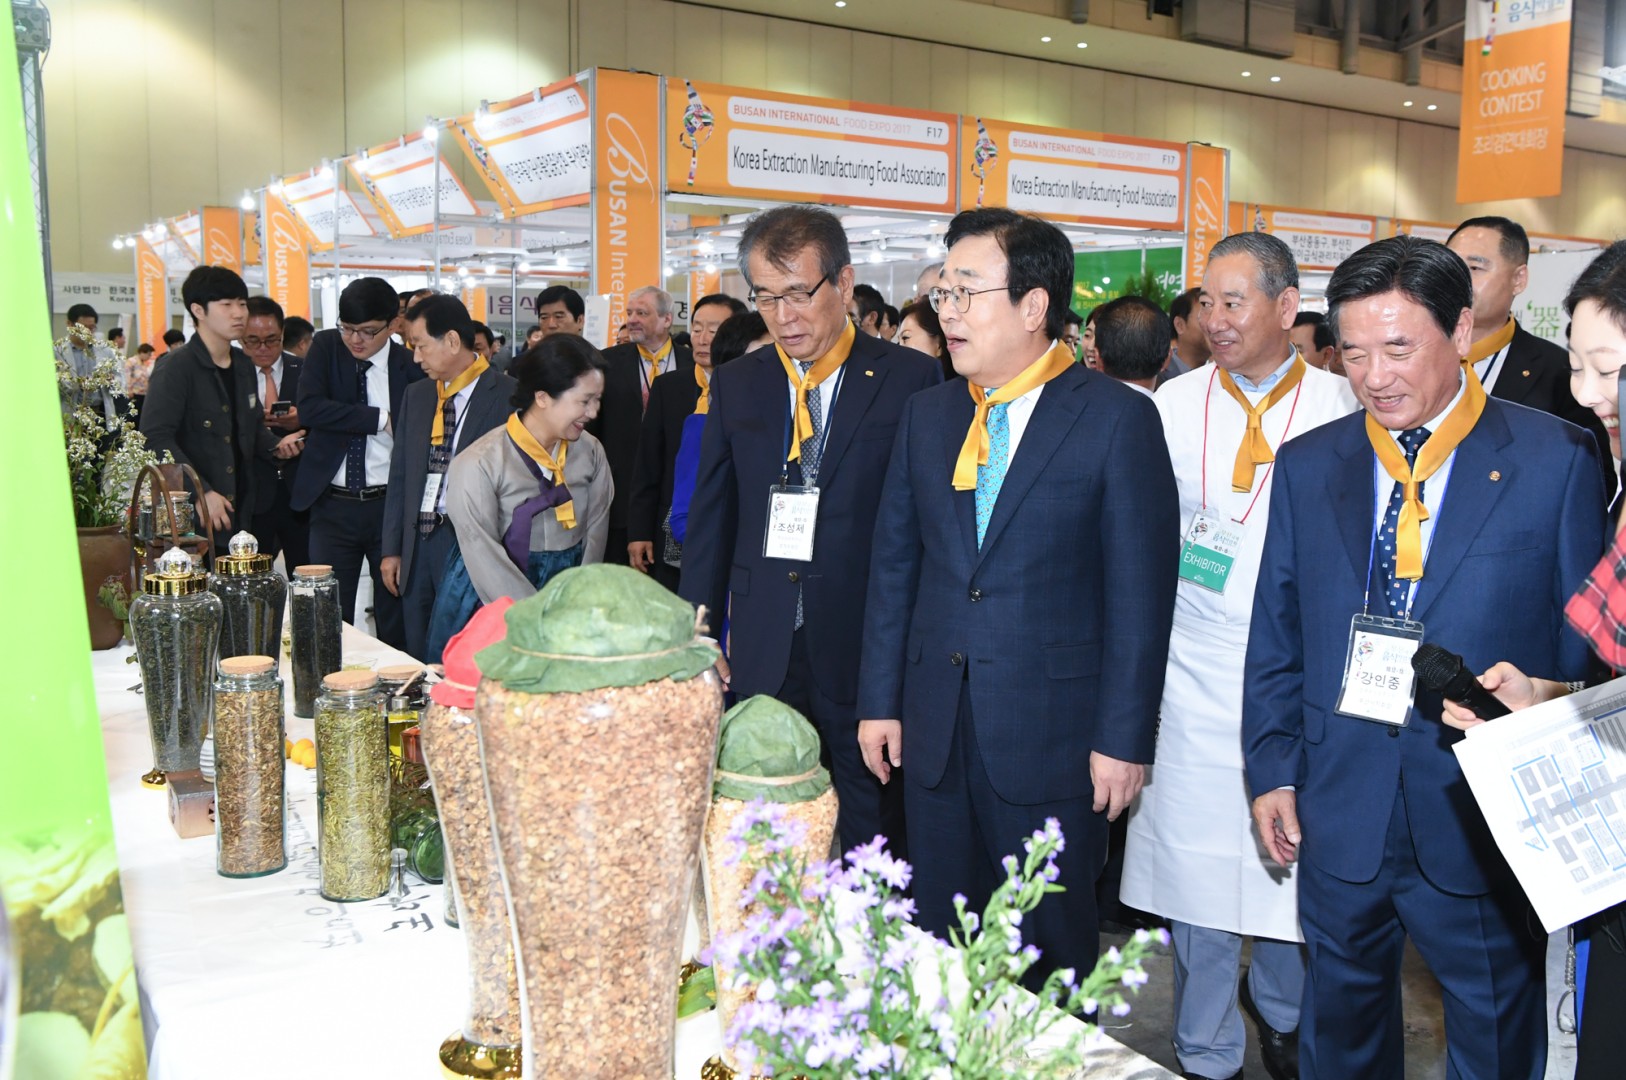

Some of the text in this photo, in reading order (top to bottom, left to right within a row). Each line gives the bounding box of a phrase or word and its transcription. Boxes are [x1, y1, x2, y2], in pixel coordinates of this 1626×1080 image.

[1481, 62, 1547, 92] COOKING
[1480, 89, 1544, 118] CONTEST
[733, 104, 943, 139] BUSAN INTERNATIONAL FOOD EXPO 2017 F17
[733, 145, 947, 188] Korea Extraction Manufacturing Food Association
[1013, 138, 1039, 150] BUSAN
[1039, 141, 1096, 157] INTERNATIONAL
[1162, 154, 1175, 165] F17
[606, 113, 655, 247] BUSAN
[1011, 174, 1177, 209] Korea Extraction Manufacturing Food Association
[1193, 177, 1220, 277] BUSAN
[272, 211, 306, 287] BUSAN
[63, 285, 101, 295] 사단법인
[777, 522, 805, 534] 조성제
[1183, 551, 1227, 577] EXHIBITOR
[1360, 671, 1400, 691] 강인중
